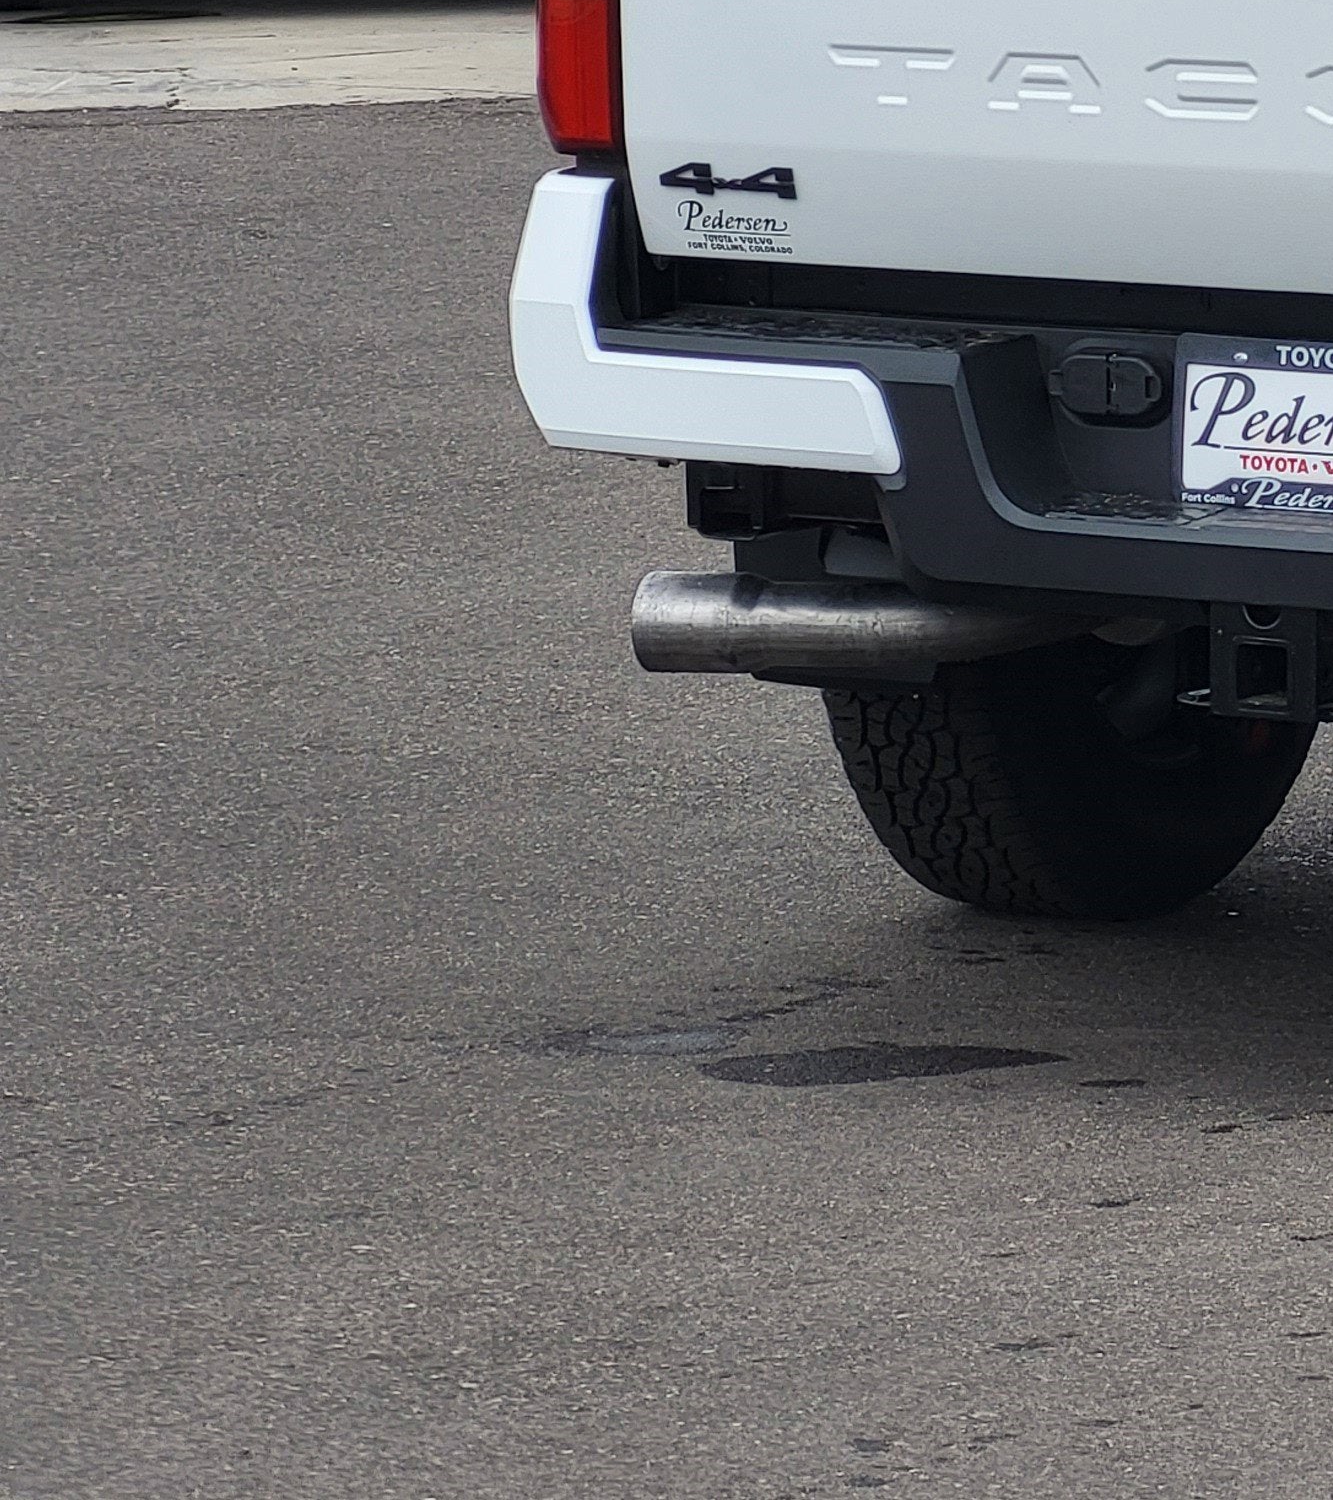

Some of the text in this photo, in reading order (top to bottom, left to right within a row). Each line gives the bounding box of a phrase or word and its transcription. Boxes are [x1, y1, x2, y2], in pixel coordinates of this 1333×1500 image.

[677, 200, 788, 232] Pedersen
[1239, 454, 1309, 475] TOYOTA
[1181, 492, 1236, 505] Fort Collins
